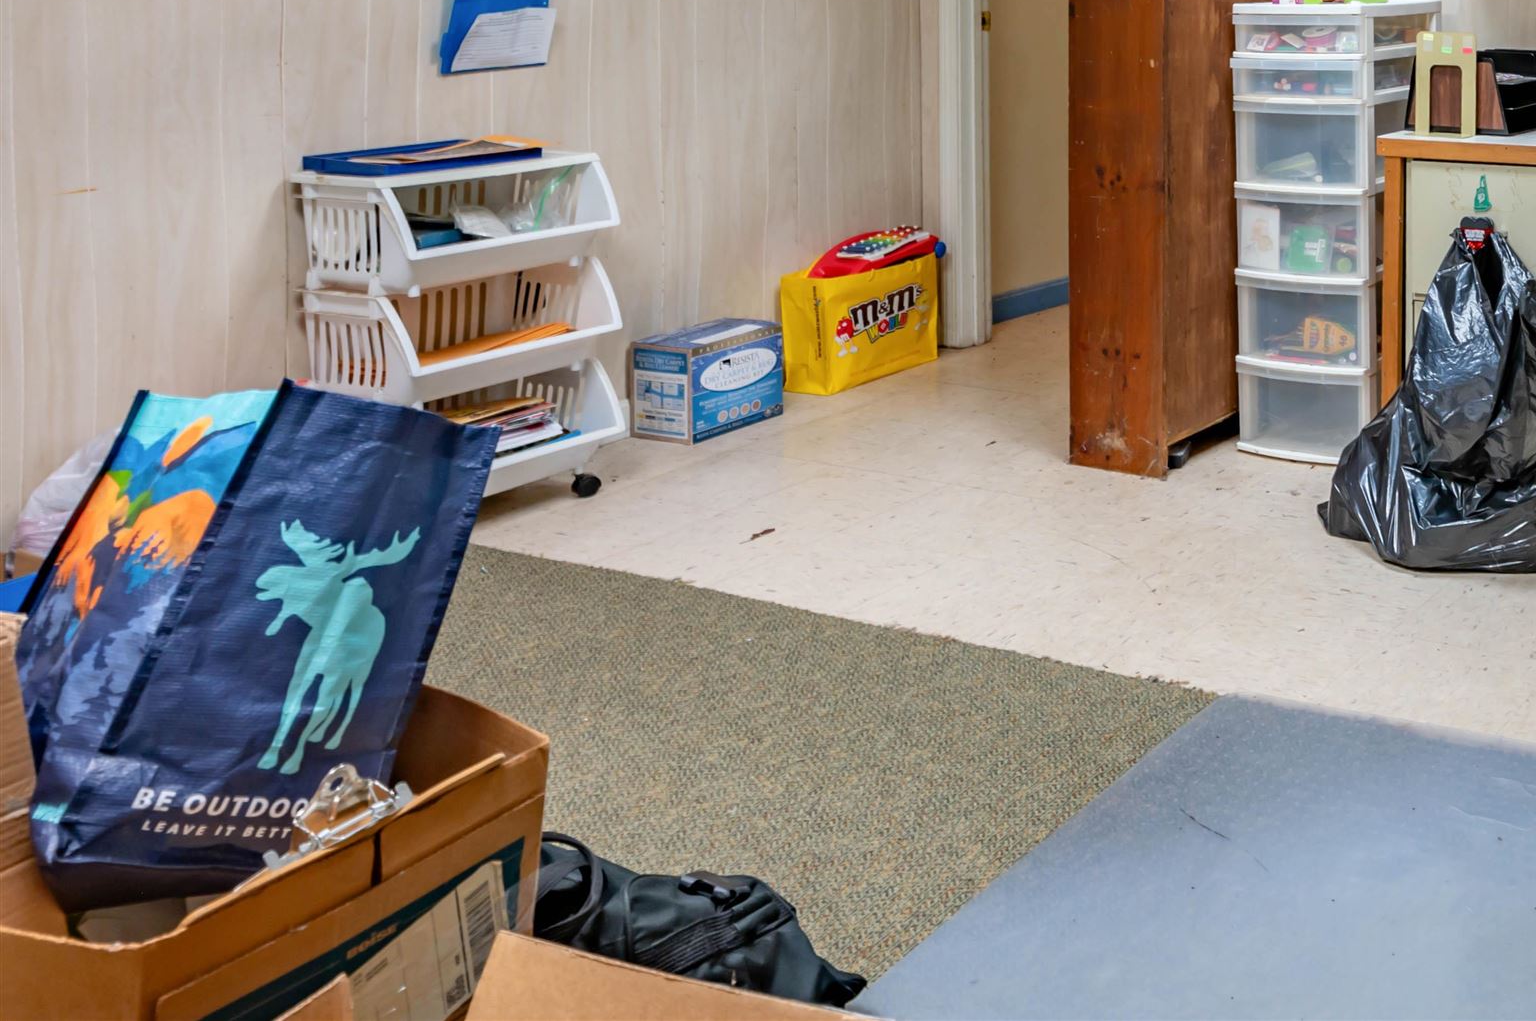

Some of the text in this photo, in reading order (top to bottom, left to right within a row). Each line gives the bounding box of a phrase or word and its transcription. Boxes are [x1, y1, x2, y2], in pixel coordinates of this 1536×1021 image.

[131, 786, 176, 812] BE
[141, 820, 206, 836] LEAVE
[214, 826, 236, 837] IT
